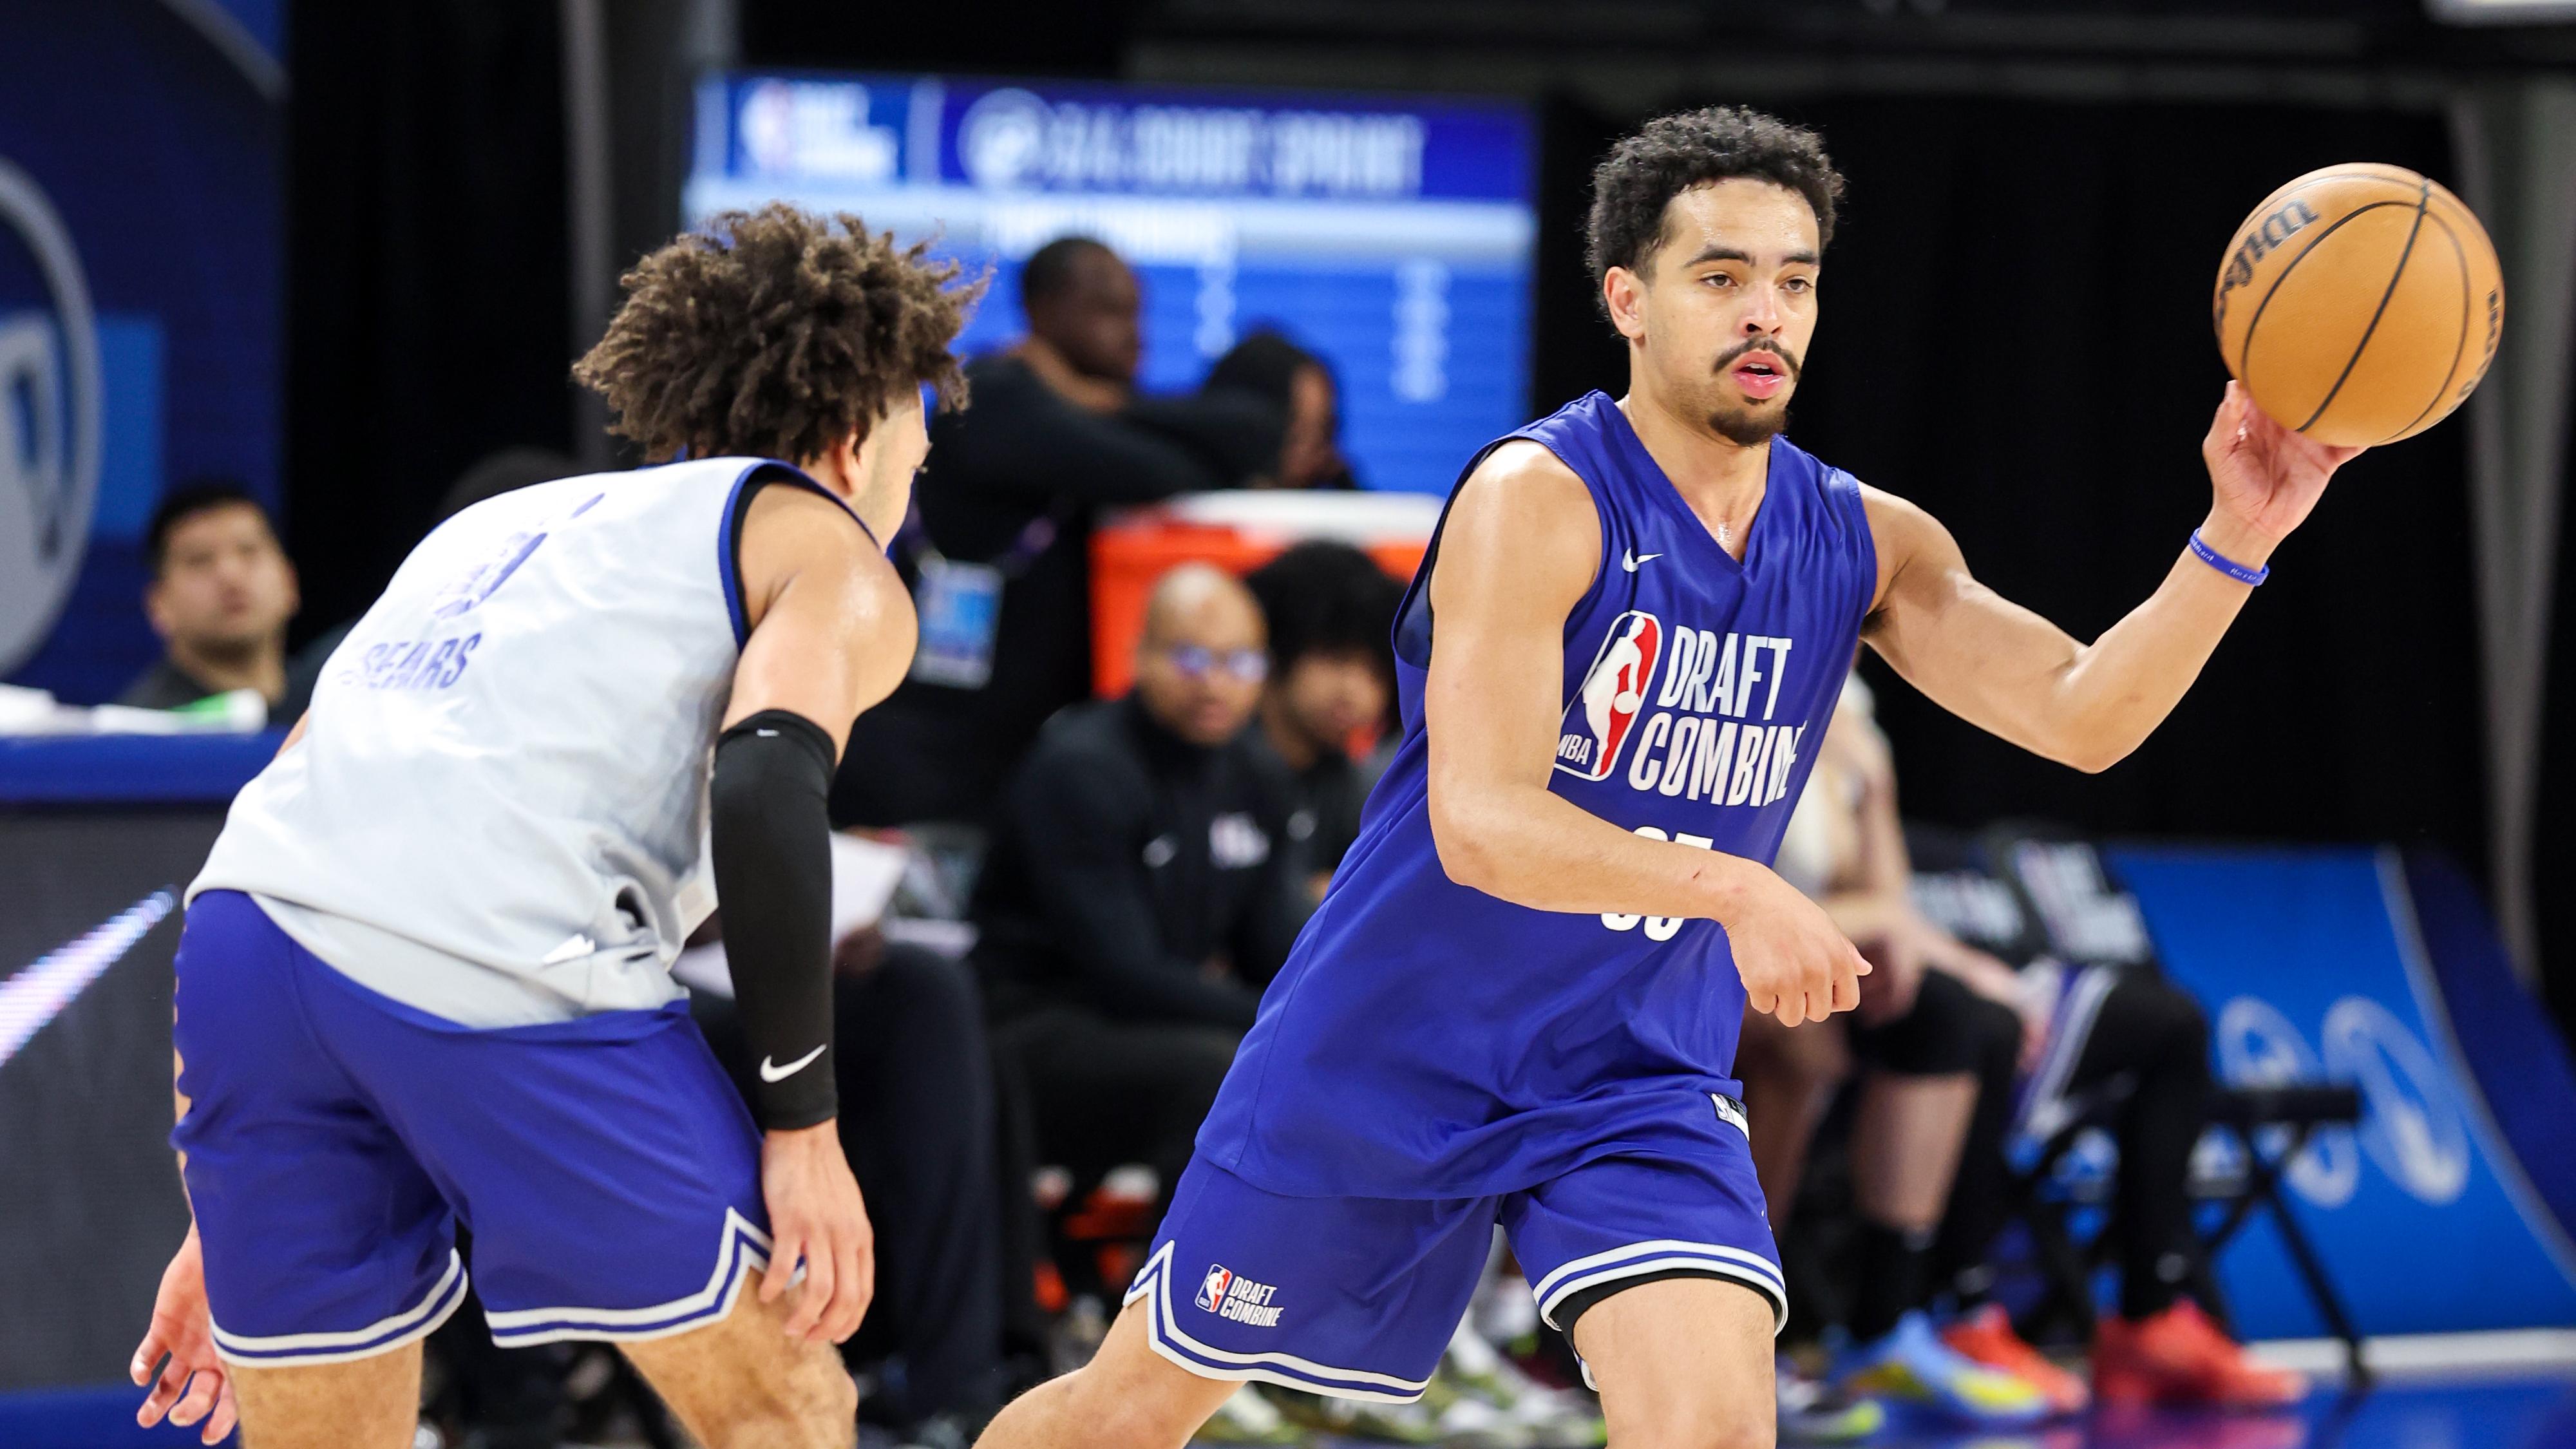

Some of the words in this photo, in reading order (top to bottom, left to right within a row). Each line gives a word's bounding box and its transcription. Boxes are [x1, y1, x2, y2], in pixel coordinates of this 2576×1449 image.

[1656, 625, 1792, 721] DRAFT
[1557, 734, 1593, 765] NBA
[1228, 1276, 1278, 1306] DRAFT
[1218, 1296, 1285, 1327] COMBINE
